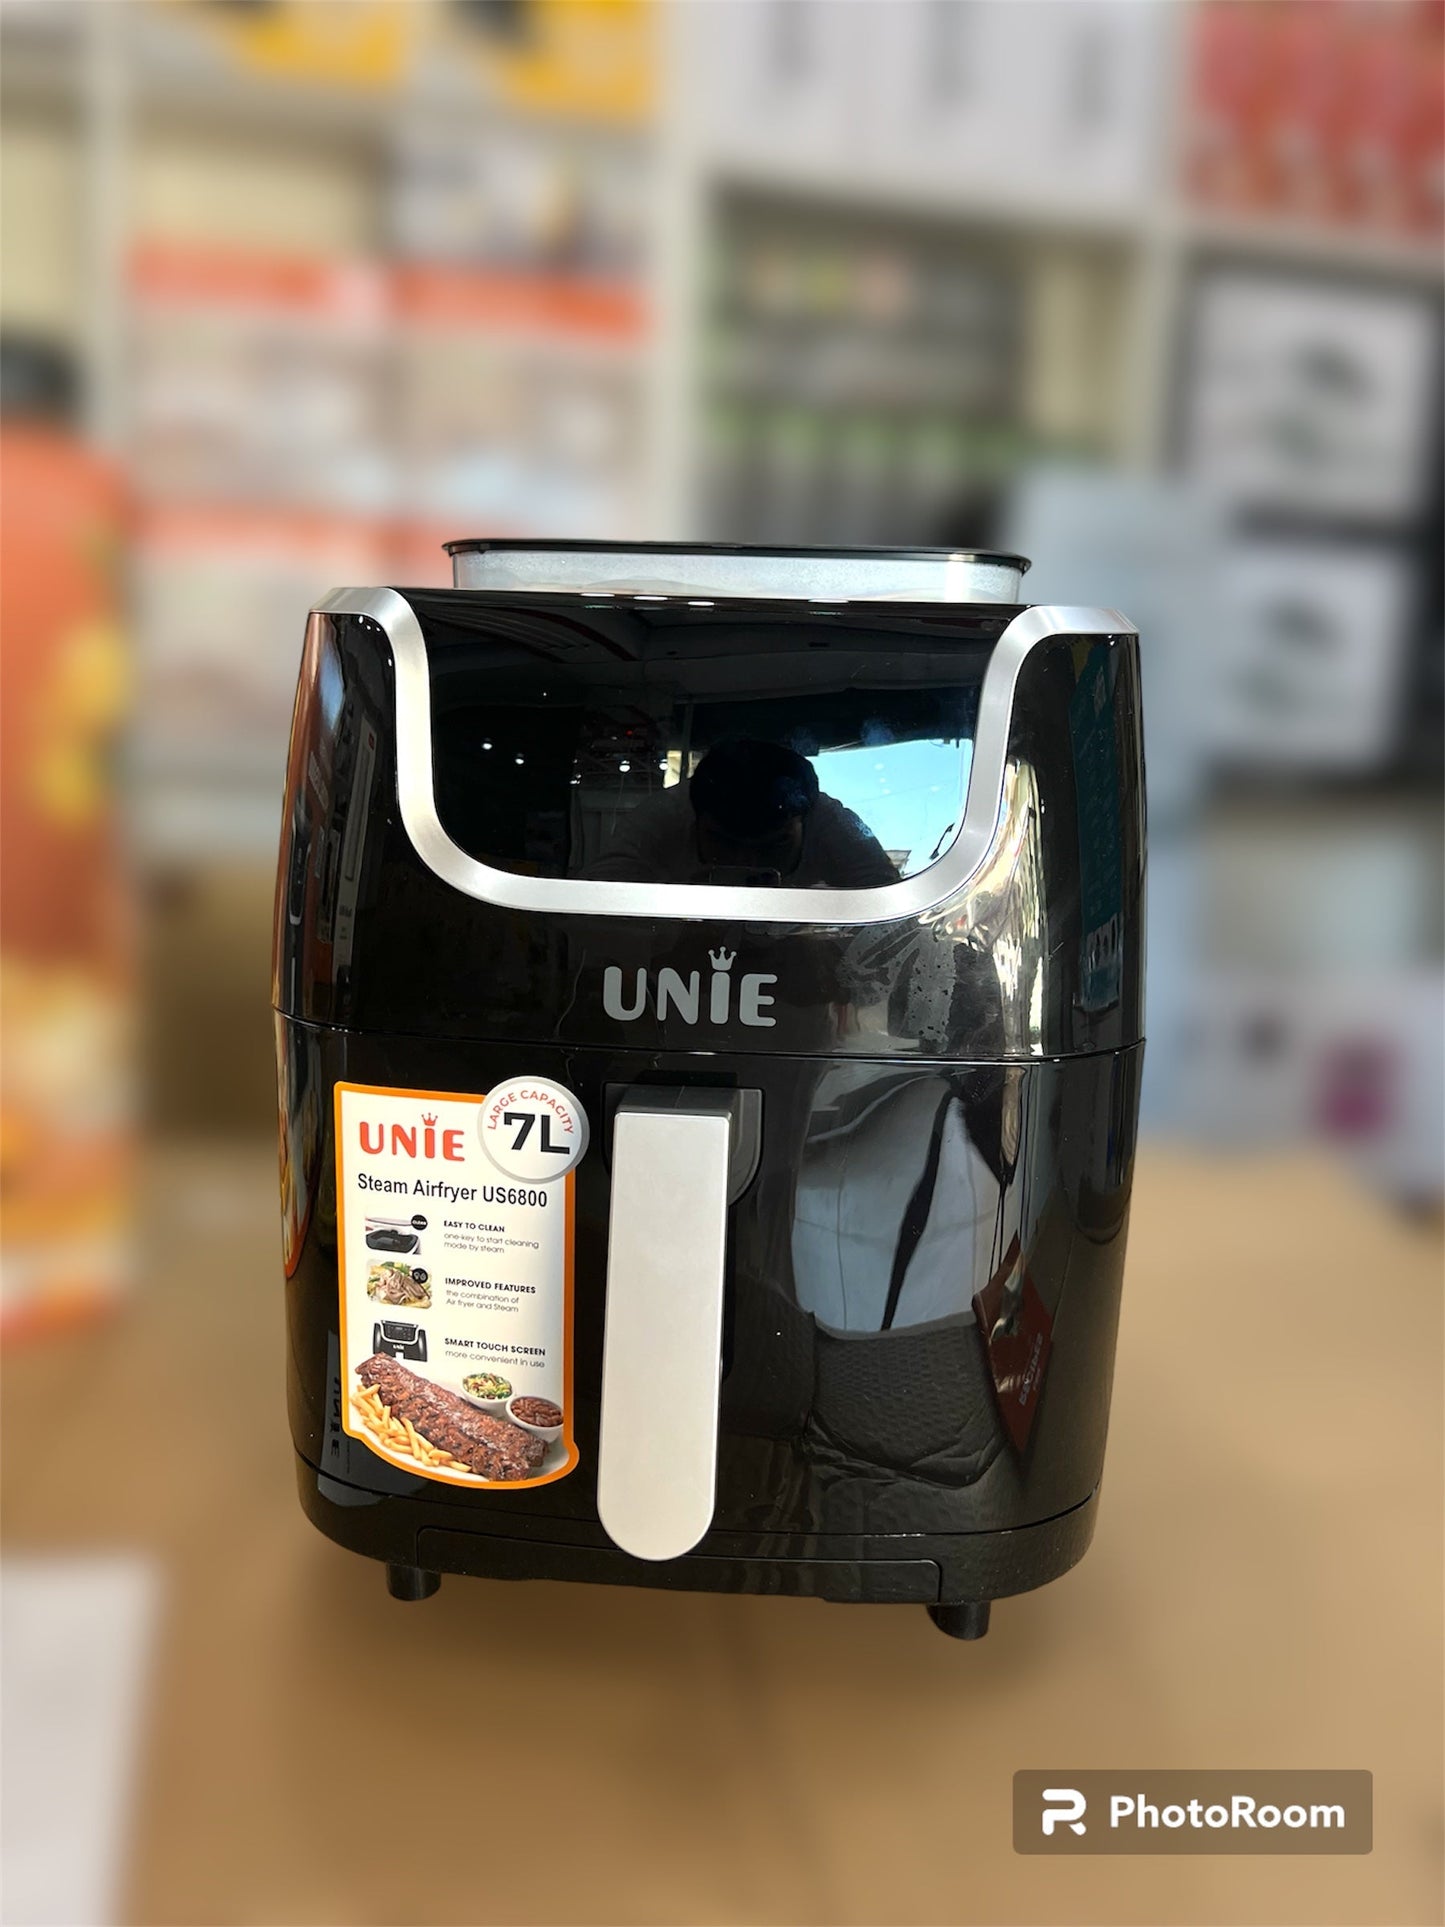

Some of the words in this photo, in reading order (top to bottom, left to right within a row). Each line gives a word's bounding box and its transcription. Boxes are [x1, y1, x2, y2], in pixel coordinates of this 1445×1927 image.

[603, 966, 777, 1027] UNIE
[487, 1092, 517, 1130] LARGE
[520, 1090, 574, 1134] CAPACITY
[359, 1121, 465, 1161] UNIE
[504, 1112, 570, 1154] 7L
[358, 1173, 408, 1194] Steam
[413, 1179, 477, 1203] Airfryer
[483, 1185, 547, 1208] US6800
[443, 1220, 463, 1229] EASY
[465, 1222, 476, 1230] TO
[478, 1224, 505, 1232] CLEAN
[443, 1233, 475, 1242] one-key
[476, 1235, 485, 1243] to
[504, 1239, 540, 1250] cleaning
[443, 1242, 467, 1250] mode
[468, 1243, 479, 1252] by
[480, 1245, 505, 1254] steam
[445, 1278, 492, 1289] IMPROVED
[494, 1283, 536, 1294] FEATURES
[446, 1289, 459, 1297] the
[460, 1291, 509, 1302] combination
[510, 1296, 519, 1304] of
[457, 1299, 475, 1308] fryer
[476, 1301, 492, 1310] and
[493, 1303, 519, 1313] Steam
[444, 1337, 474, 1349] SMART
[476, 1341, 509, 1353] TOUCH
[510, 1345, 546, 1357] SCREEN
[444, 1349, 468, 1359] more
[469, 1352, 519, 1365] convenient
[519, 1357, 529, 1366] in
[529, 1359, 546, 1368] use
